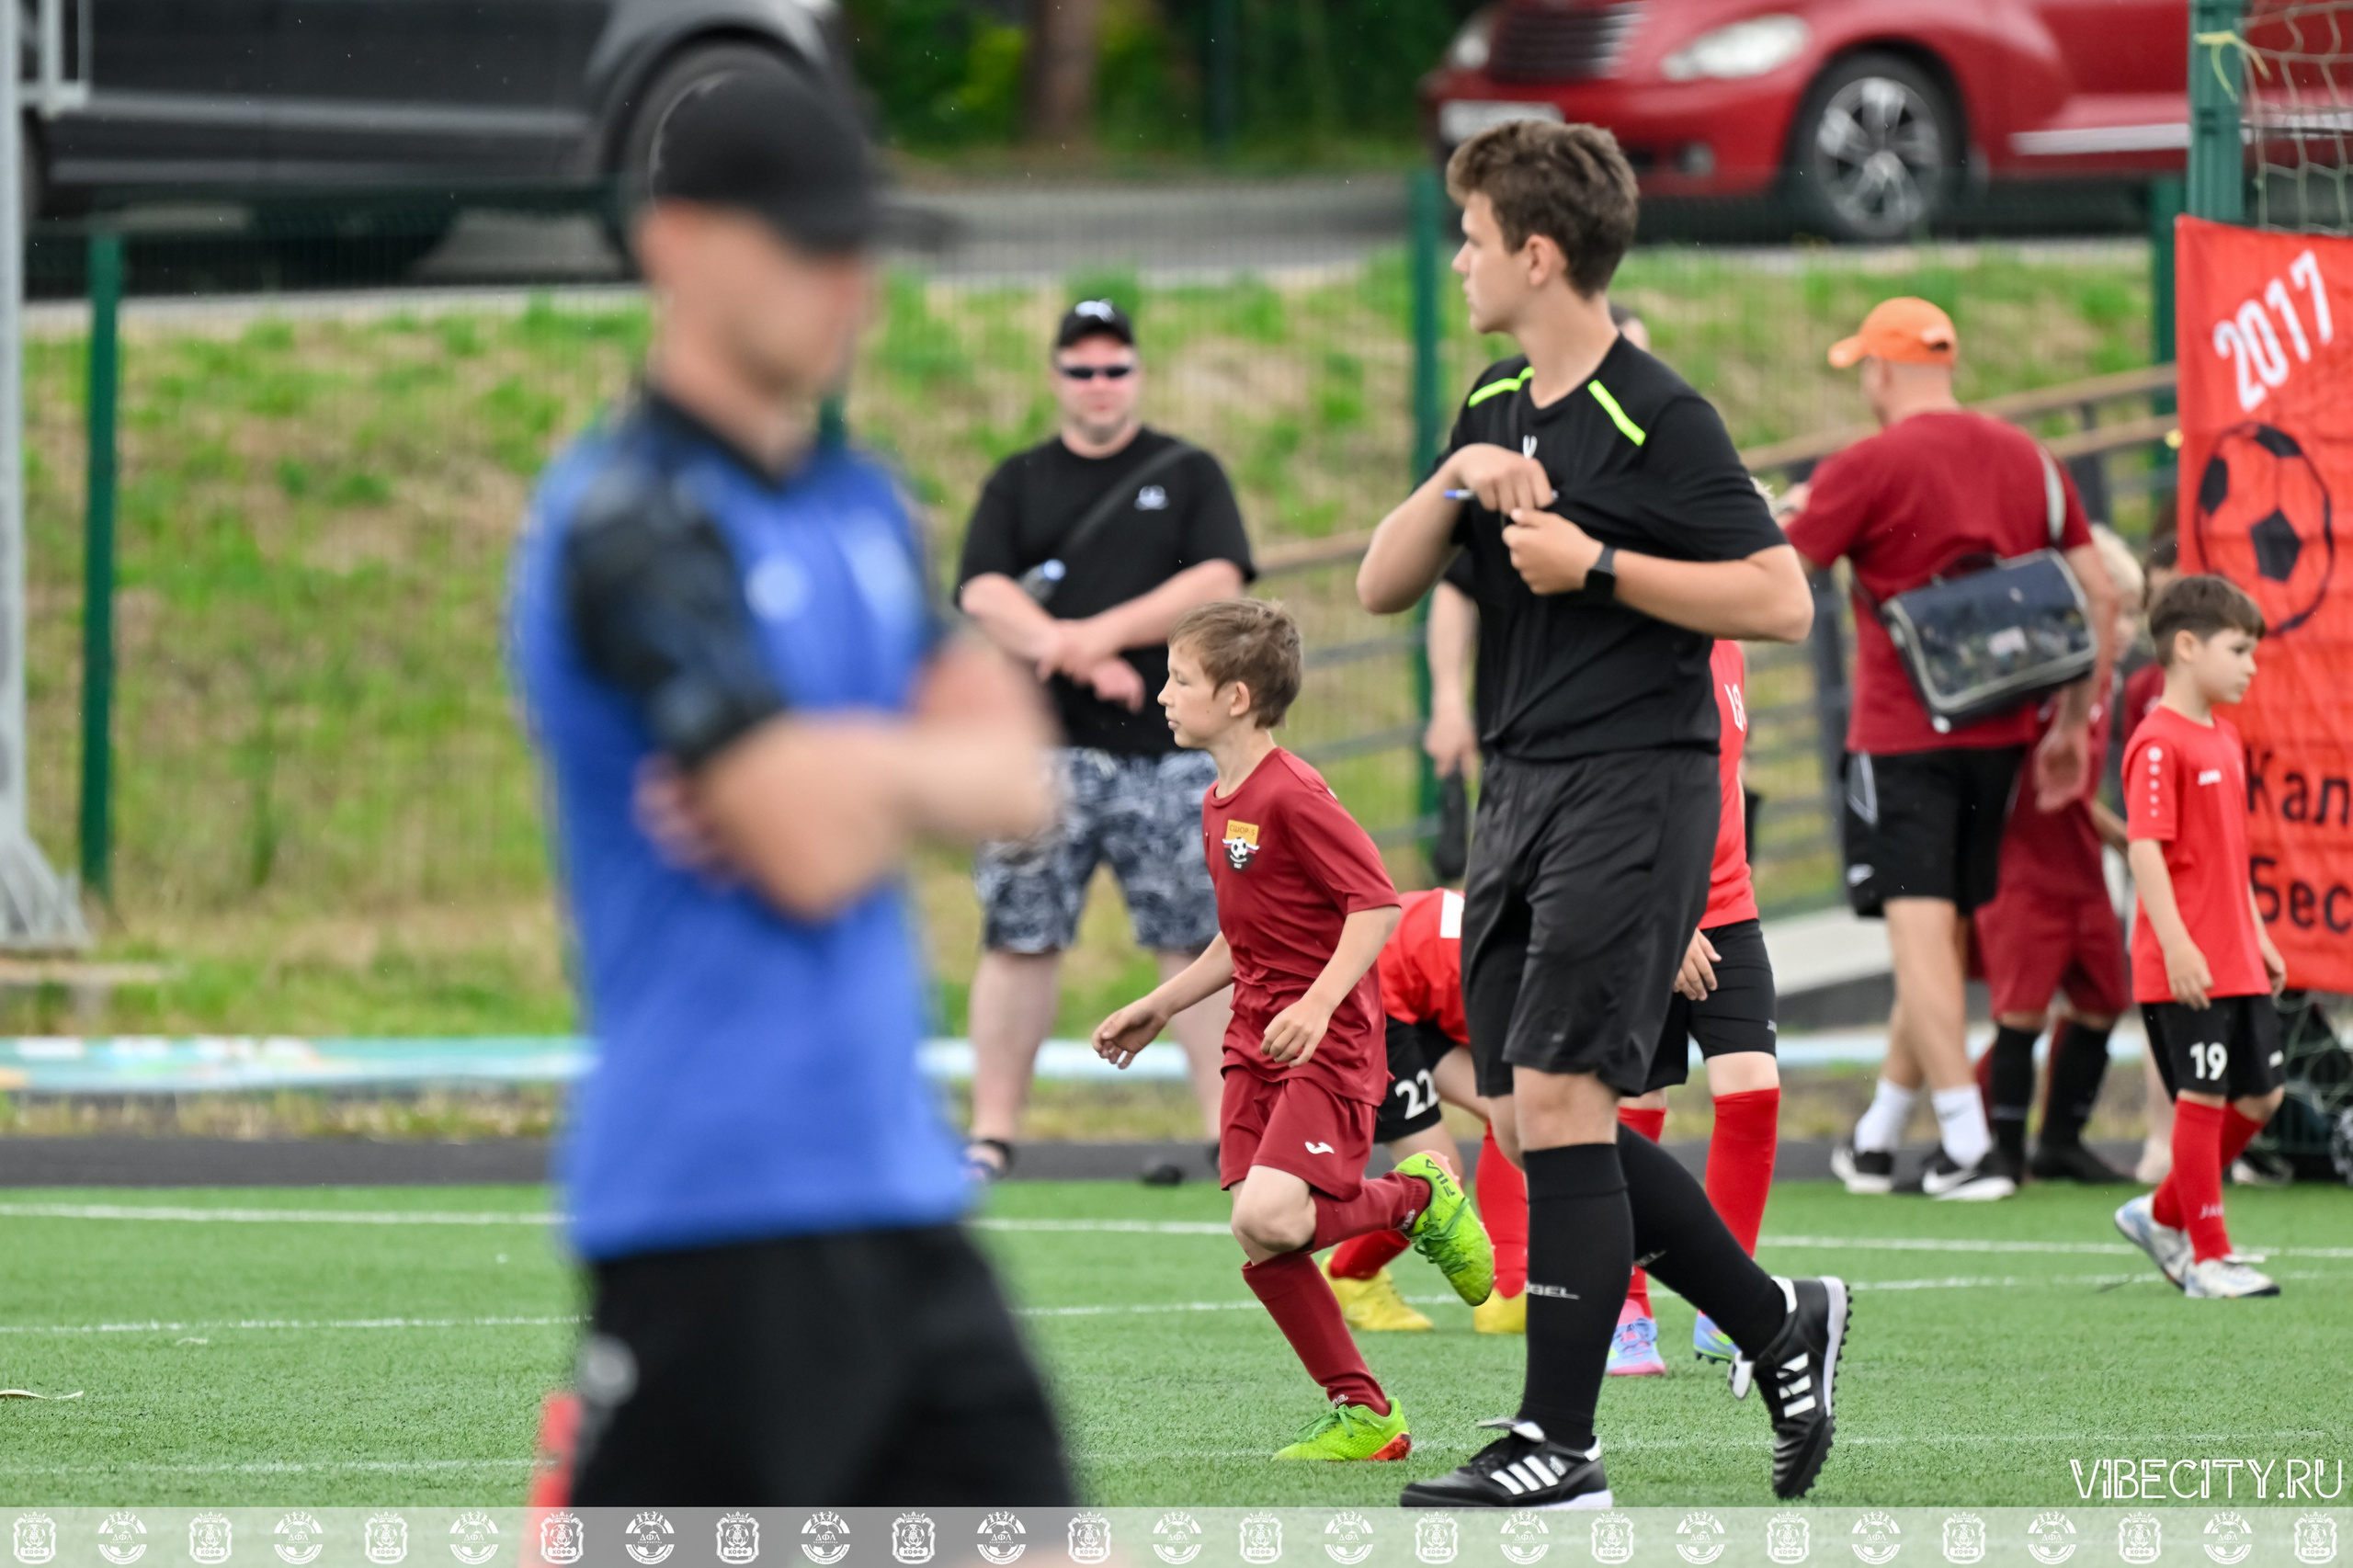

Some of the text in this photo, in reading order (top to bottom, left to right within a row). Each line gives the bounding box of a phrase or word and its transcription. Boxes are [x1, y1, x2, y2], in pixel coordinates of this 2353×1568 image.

[2213, 250, 2334, 412] 2017
[2189, 1041, 2228, 1081] 19
[1426, 1159, 1455, 1197] FILA
